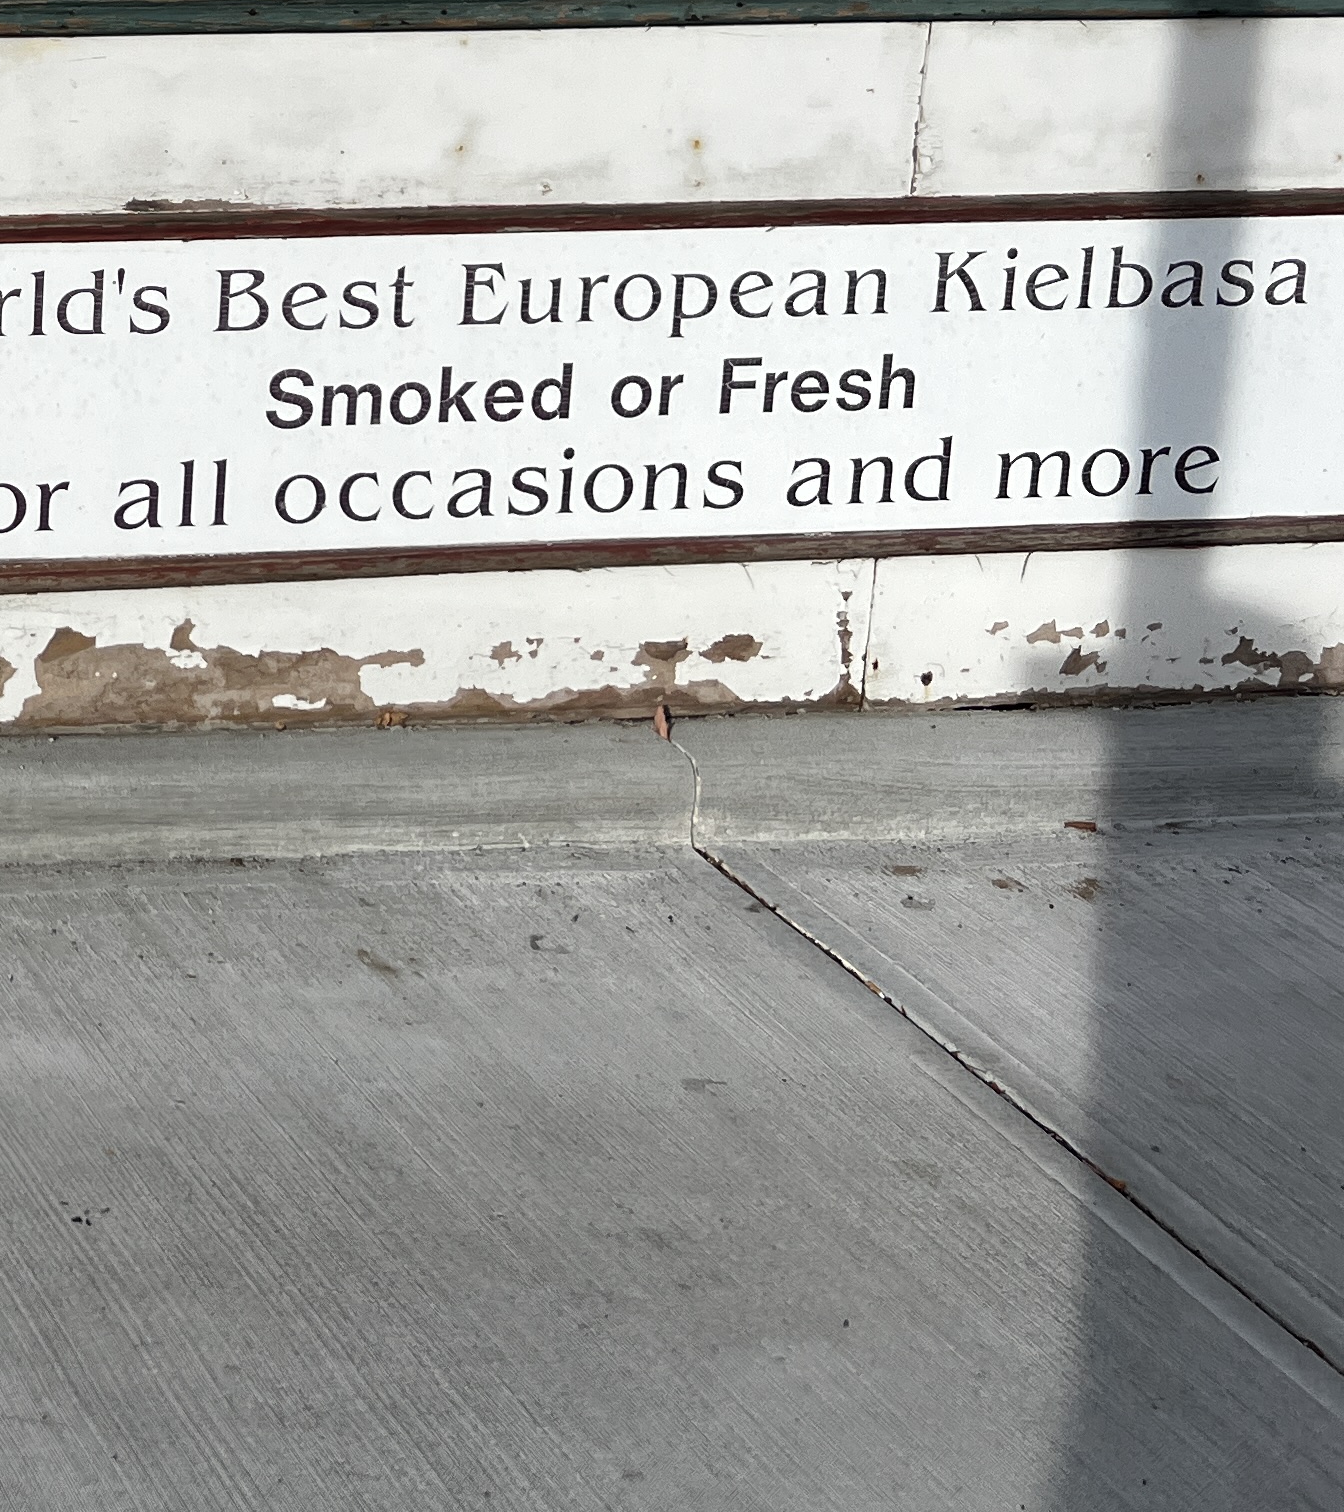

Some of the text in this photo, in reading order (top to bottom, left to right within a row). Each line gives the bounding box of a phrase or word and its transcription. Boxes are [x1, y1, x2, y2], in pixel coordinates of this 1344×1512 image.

[212, 266, 416, 333] Best
[456, 261, 889, 338] European
[928, 245, 1309, 313] Kielbasa
[265, 352, 917, 430] Smoked or Fresh
[113, 458, 229, 531] all
[274, 446, 745, 525] occasions
[786, 434, 955, 508] and
[993, 444, 1222, 500] more
